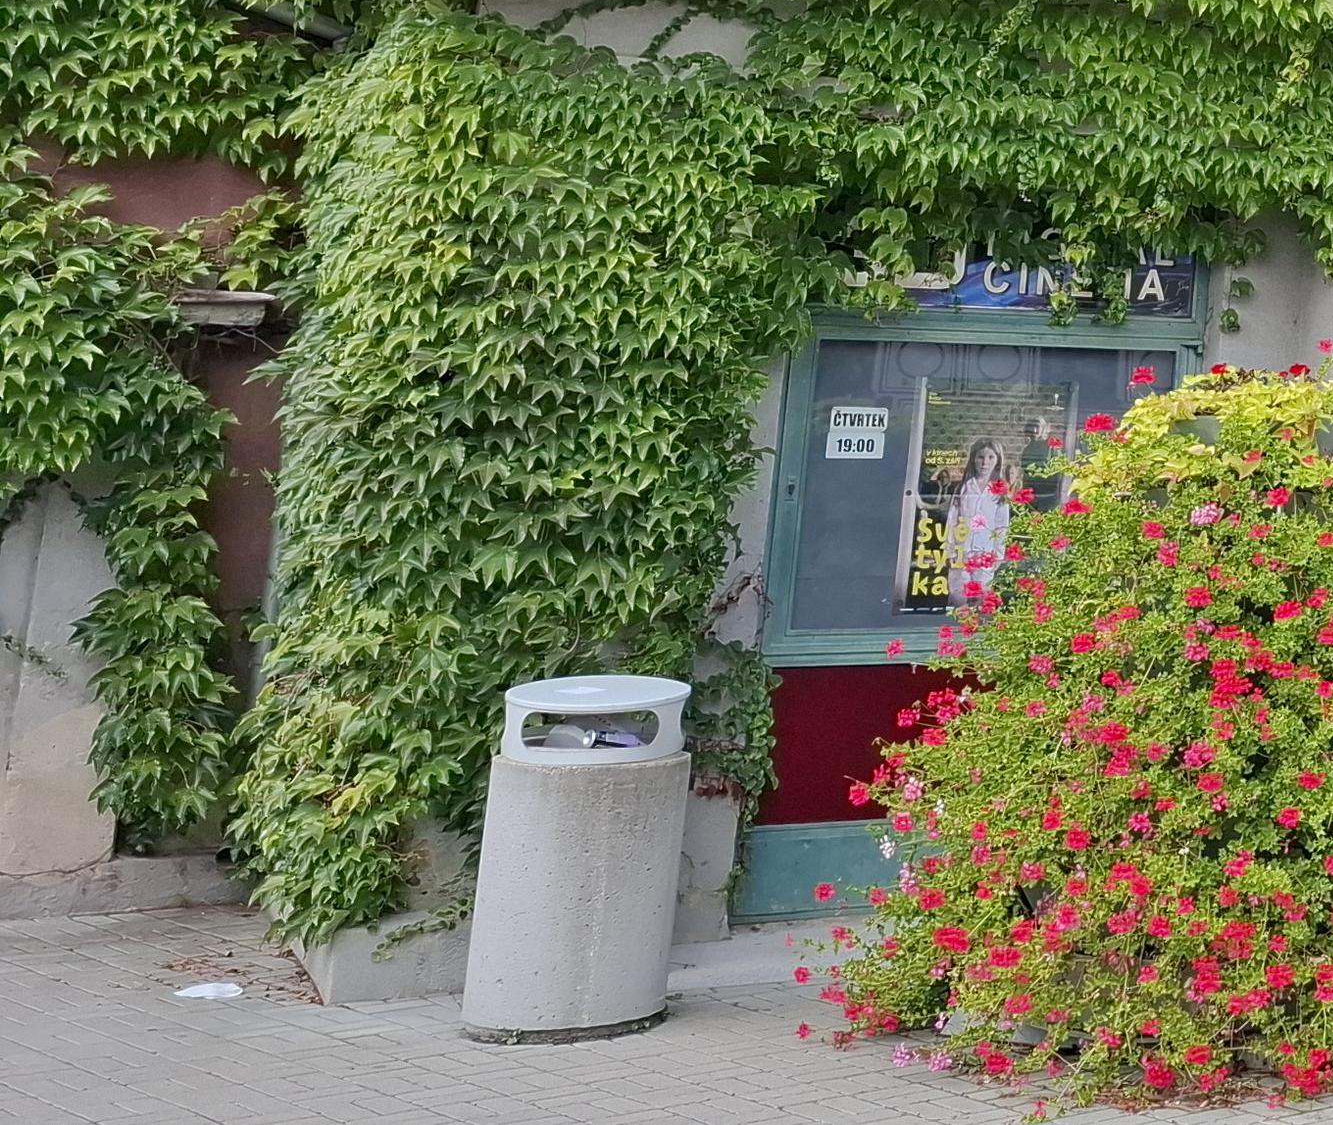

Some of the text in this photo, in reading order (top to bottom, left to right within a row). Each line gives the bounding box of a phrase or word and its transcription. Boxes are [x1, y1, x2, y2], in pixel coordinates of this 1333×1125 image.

[983, 261, 1165, 301] CINA
[833, 409, 886, 428] ČTVRTEK
[836, 438, 875, 453] 19:00
[916, 516, 970, 543] Svě
[911, 571, 949, 596] ka
